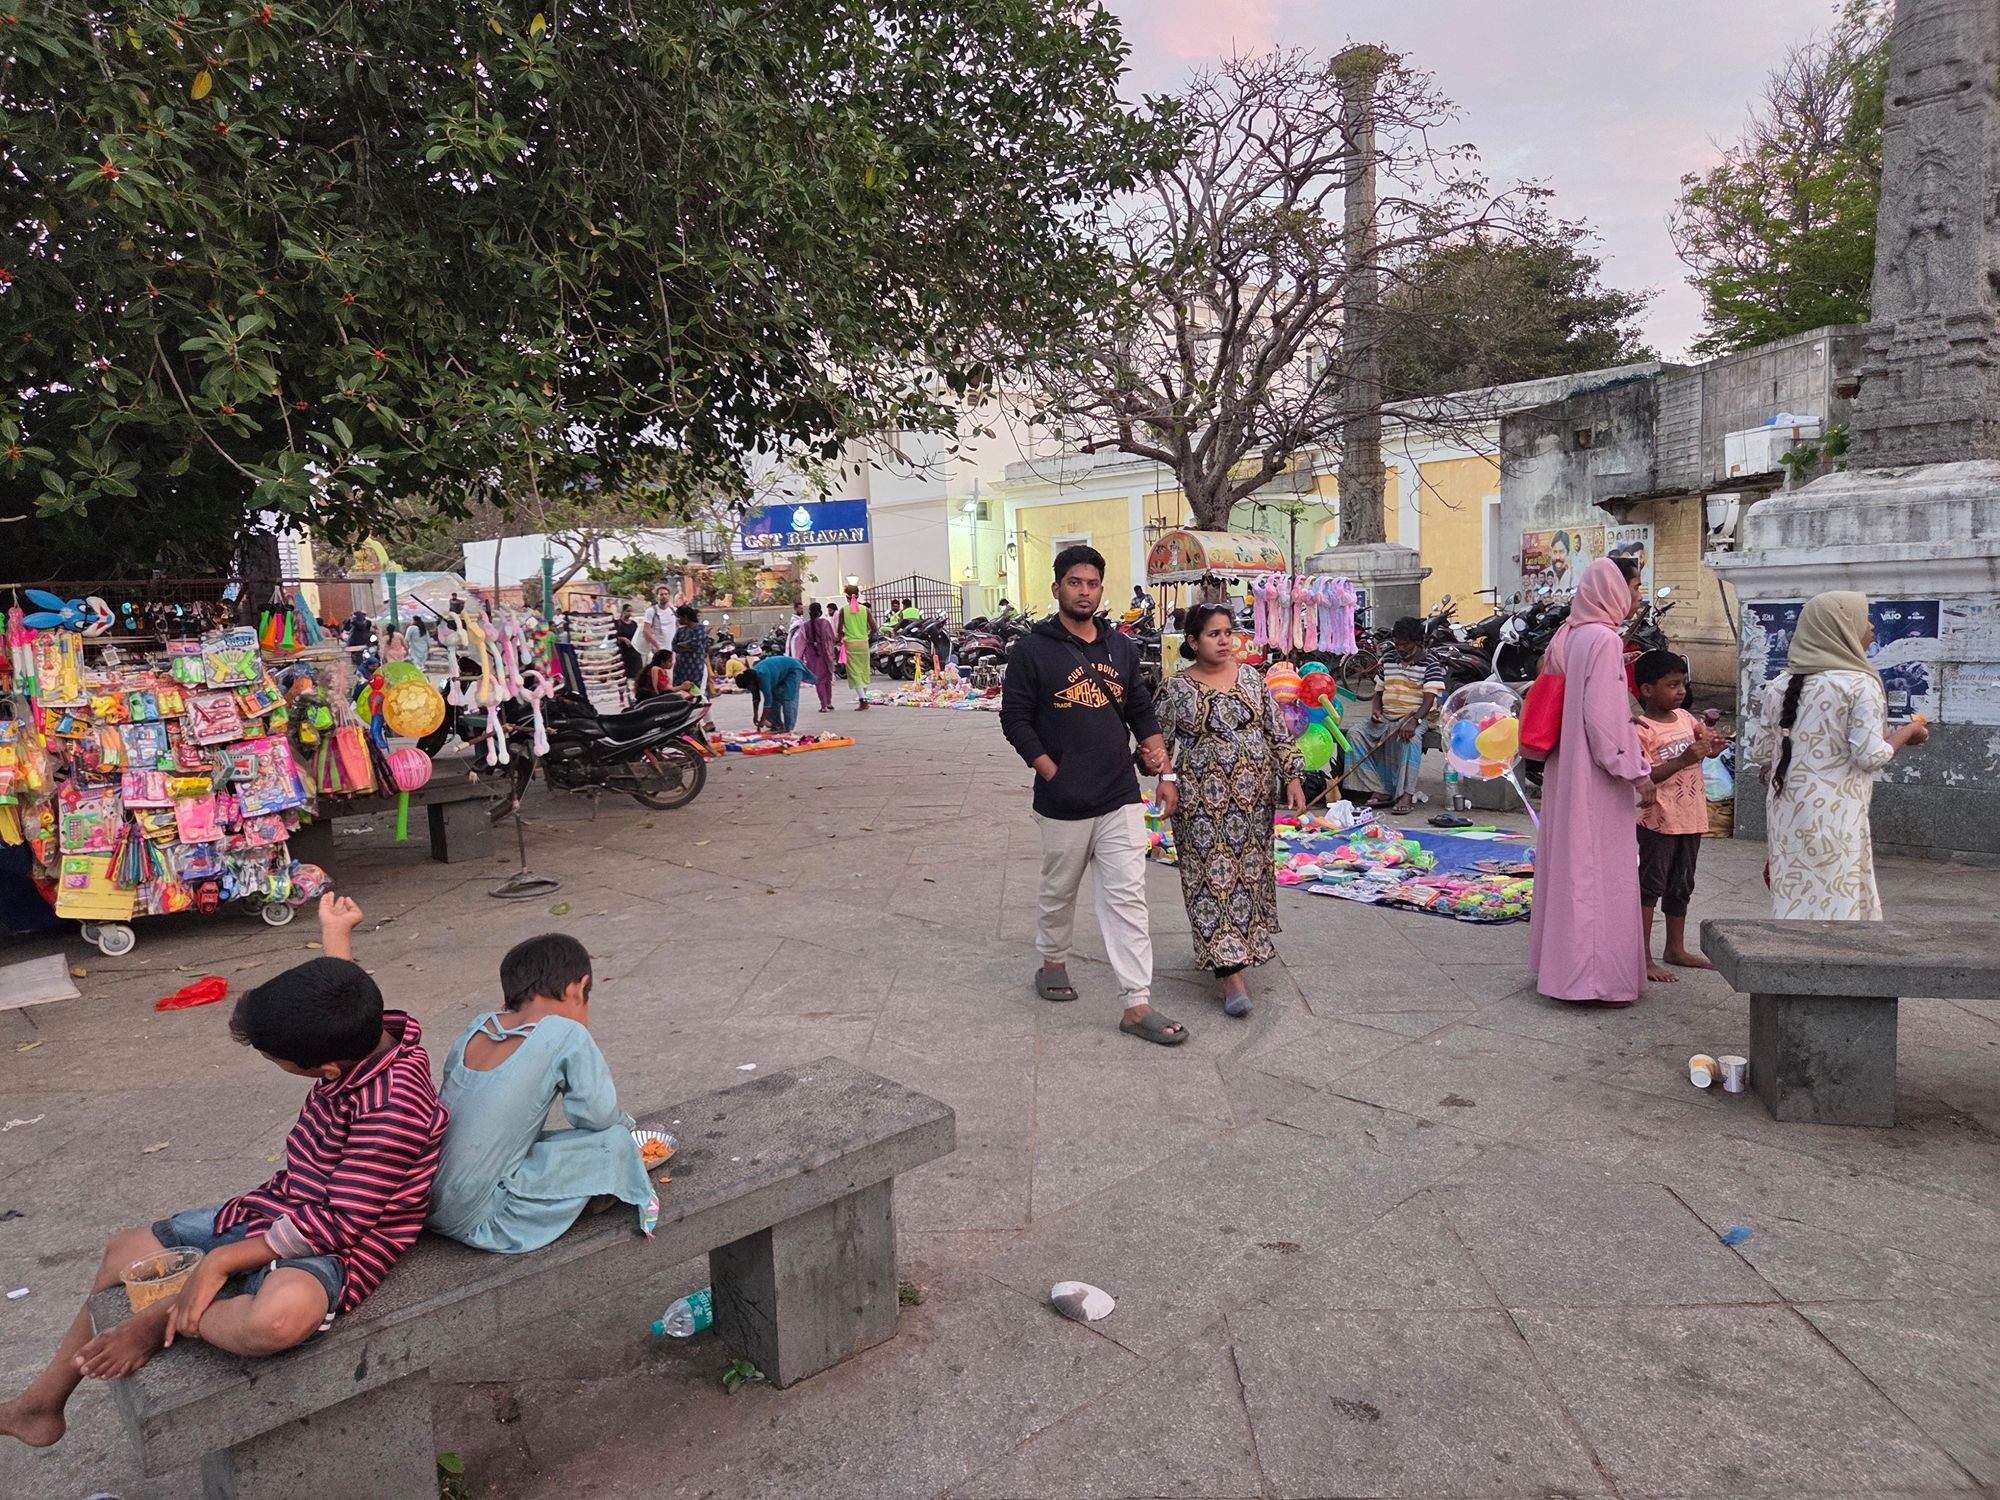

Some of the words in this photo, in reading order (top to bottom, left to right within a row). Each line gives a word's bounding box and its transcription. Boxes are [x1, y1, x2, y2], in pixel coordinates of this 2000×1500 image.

[744, 533, 783, 548] GST
[786, 528, 864, 545] BHAVAN
[1067, 665, 1096, 683] CUST
[1097, 663, 1120, 679] BUILT
[1066, 682, 1092, 705] SUPER
